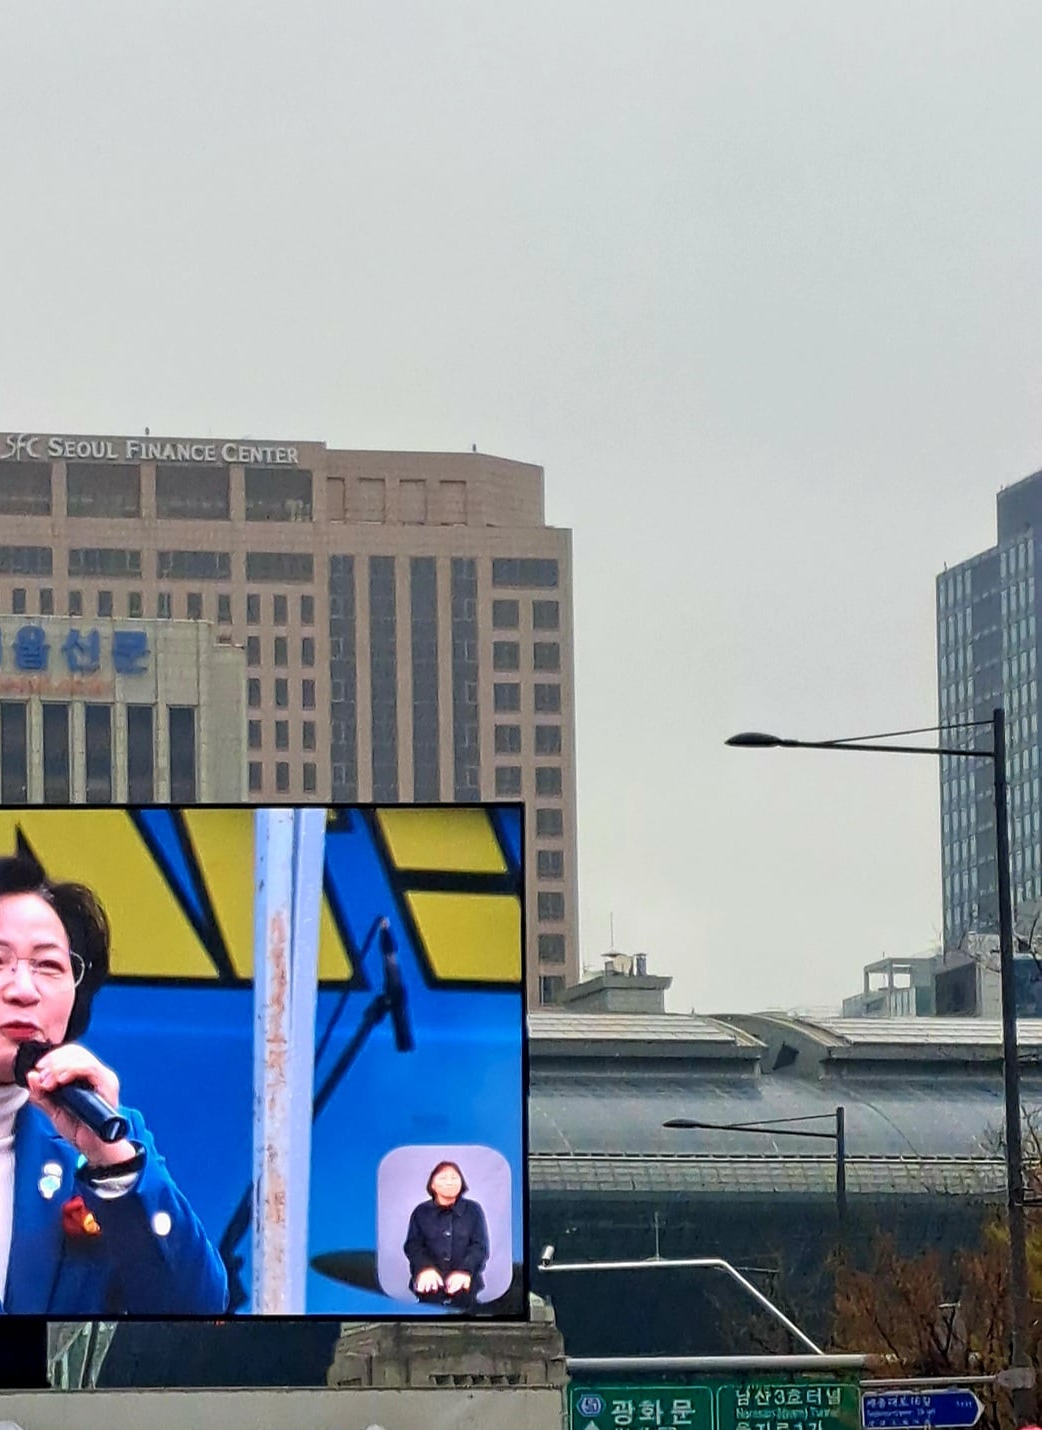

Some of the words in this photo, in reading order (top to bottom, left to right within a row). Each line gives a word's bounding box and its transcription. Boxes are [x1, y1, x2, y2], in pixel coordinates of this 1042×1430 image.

[48, 439, 118, 460] SEOUL
[125, 440, 216, 462] FINANCE
[222, 442, 299, 464] CENTER
[611, 1399, 696, 1425] 광화문
